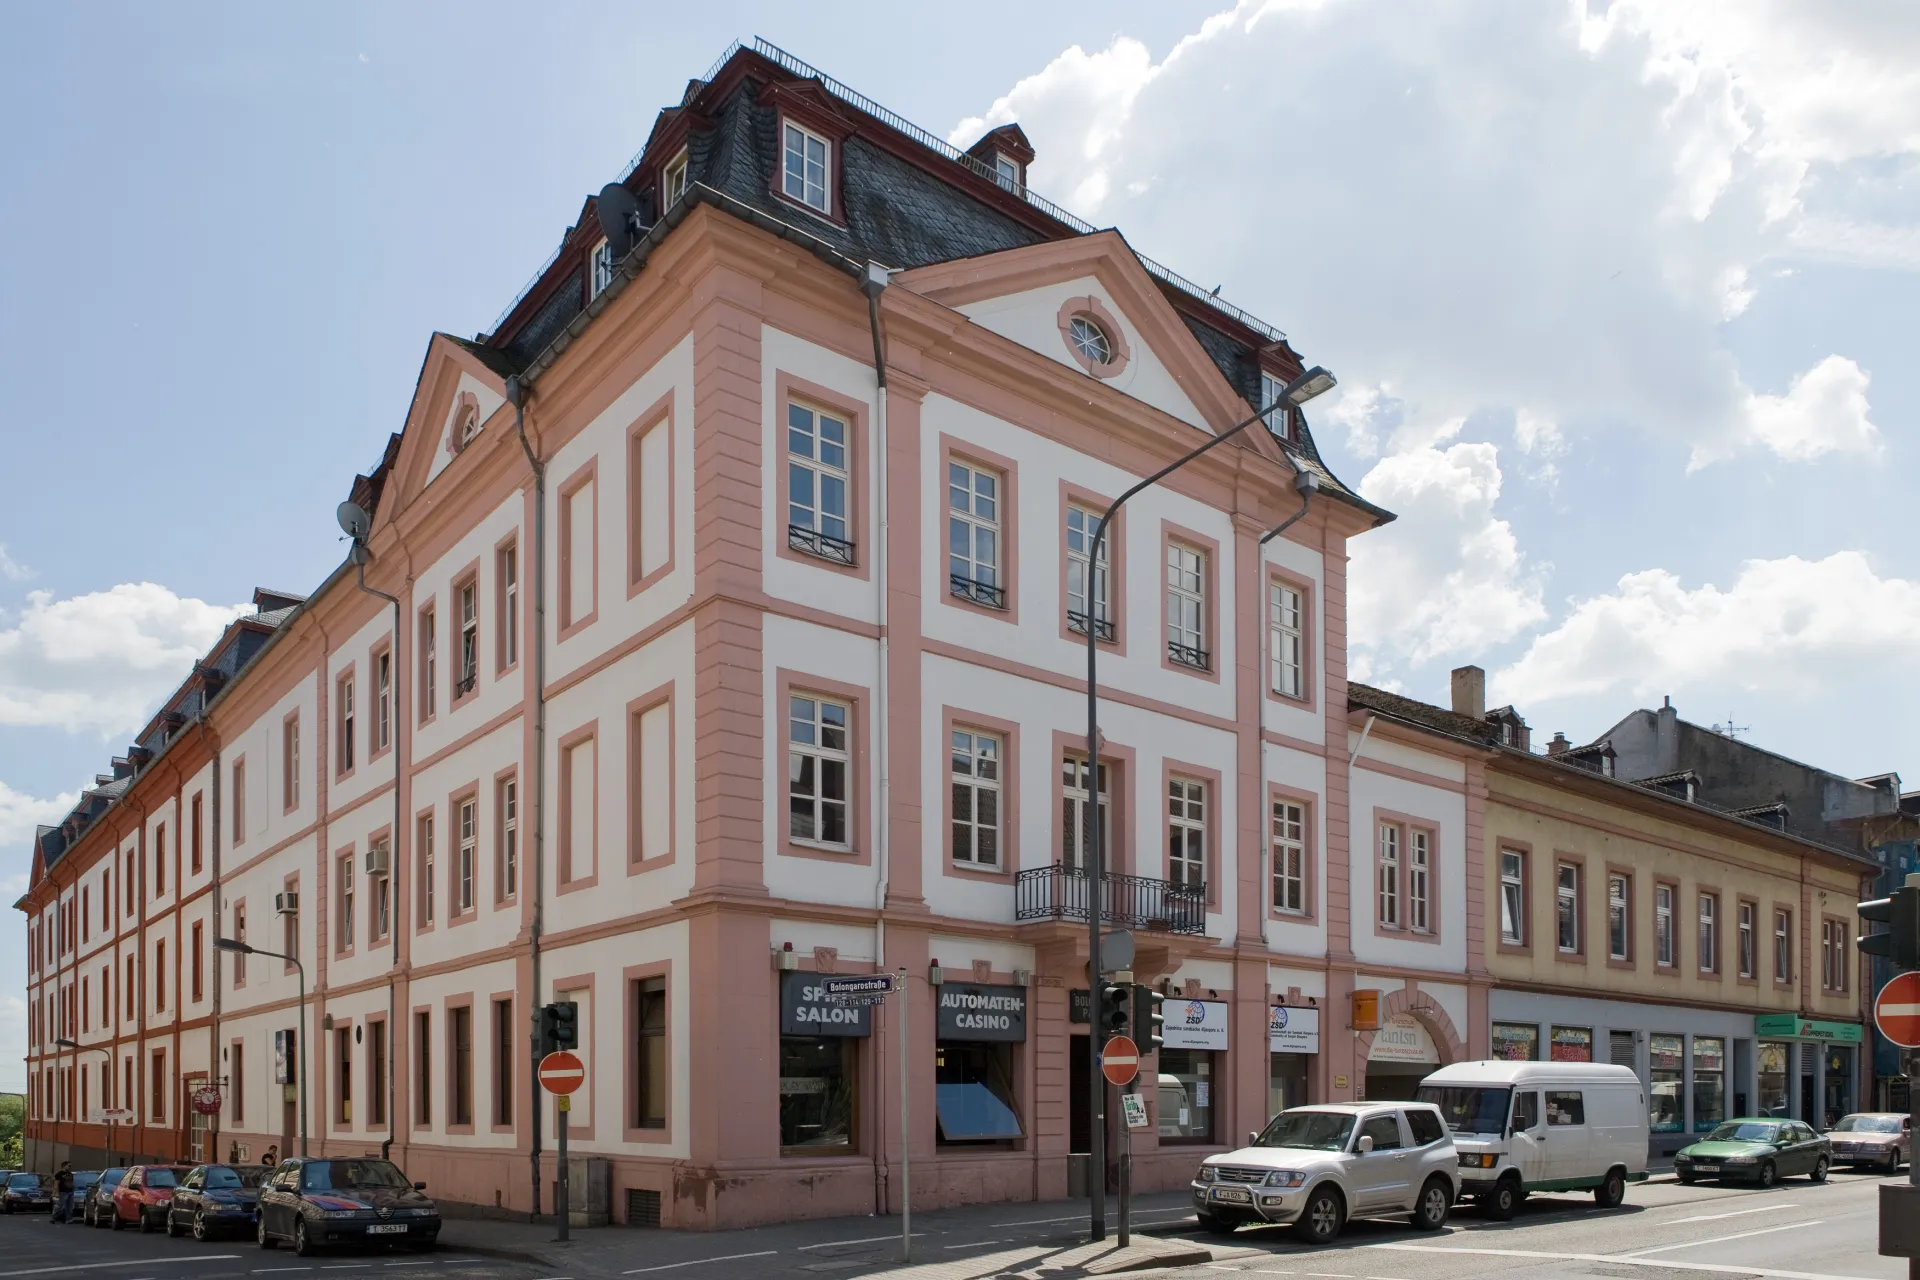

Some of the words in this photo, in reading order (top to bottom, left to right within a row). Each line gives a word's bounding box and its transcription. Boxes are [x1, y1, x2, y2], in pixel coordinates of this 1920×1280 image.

[830, 980, 886, 991] Bolongarostraße
[941, 993, 1024, 1011] AUTOMATEN-
[796, 1006, 859, 1024] SALON
[956, 1014, 1009, 1029] CASINO
[1186, 1016, 1200, 1024] ZSD
[1270, 1021, 1283, 1029] ZSD
